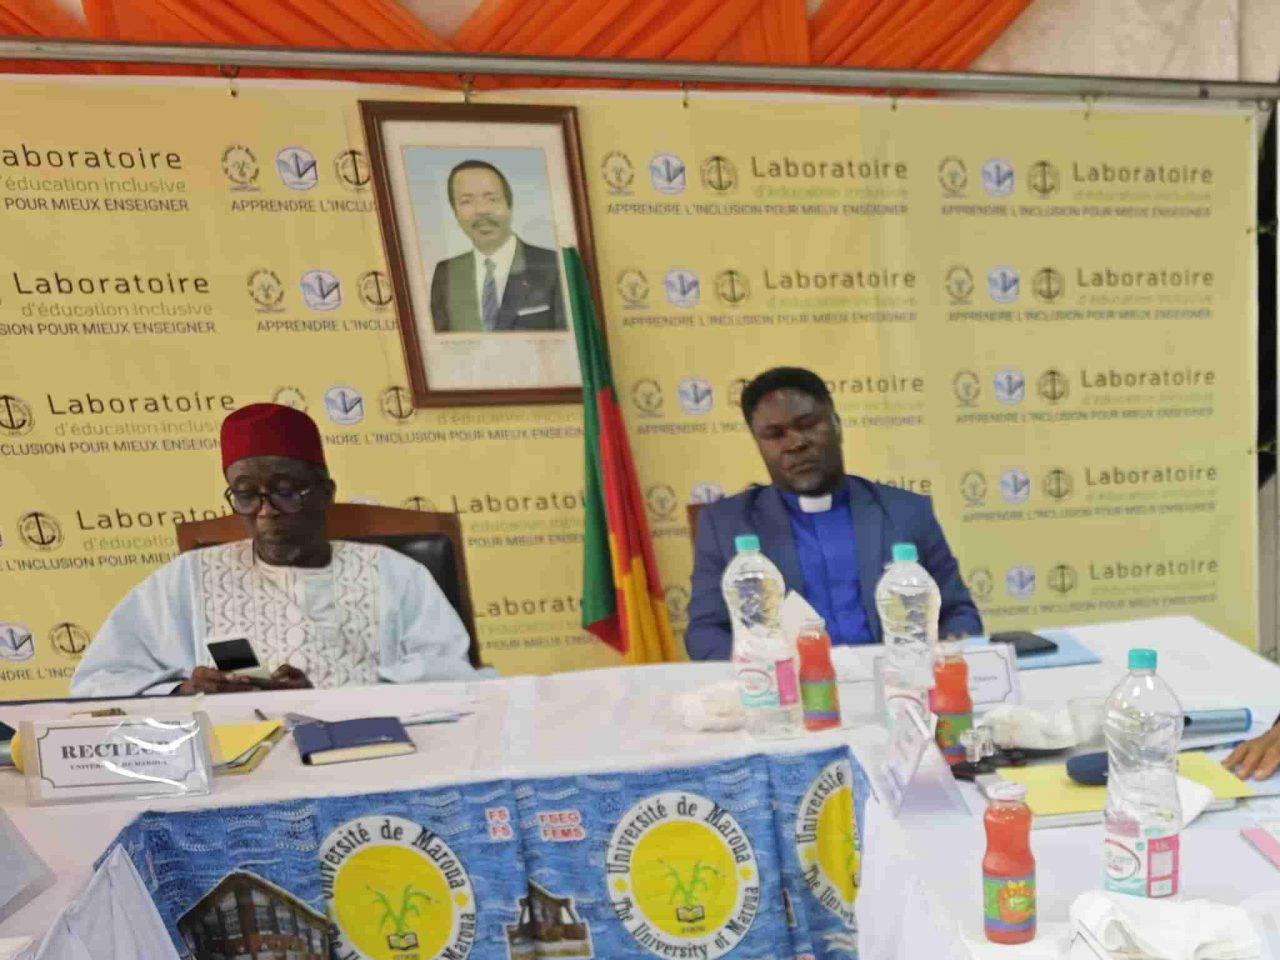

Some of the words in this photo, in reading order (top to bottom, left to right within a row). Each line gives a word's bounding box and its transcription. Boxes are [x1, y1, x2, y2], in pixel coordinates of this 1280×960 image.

[752, 156, 909, 180] Laboratoire
[1072, 160, 1213, 184] Laboratoire
[104, 177, 187, 194] inclusive
[4, 197, 49, 211] POUR
[52, 198, 101, 212] MIEUX
[105, 198, 190, 213] ENSEIGNER
[231, 199, 317, 213] APPRENDRE
[12, 271, 210, 295] Laboratoire
[763, 269, 917, 291] Laboratoire
[1076, 267, 1214, 288] Laboratoire
[132, 301, 213, 317] inclusive
[38, 322, 80, 336] POUR
[82, 322, 129, 335] MIEUX
[133, 320, 216, 335] ENSEIGNER
[257, 319, 338, 333] APPRENDRE
[1080, 368, 1216, 389] Laboratoire
[47, 391, 236, 416] Laboratoire
[70, 441, 109, 455] POUR
[113, 440, 158, 453] MIEUX
[1084, 465, 1218, 488] Laboratoire
[6, 557, 96, 573] L'INCLUSION
[99, 556, 138, 569] POUR
[1089, 558, 1220, 582] Laboratoire
[60, 740, 177, 760] RECTE
[795, 765, 847, 845] Université
[381, 819, 404, 842] de
[605, 798, 668, 875] Université
[676, 795, 698, 818] de
[803, 863, 821, 891] The
[612, 896, 635, 922] The
[714, 930, 732, 950] of
